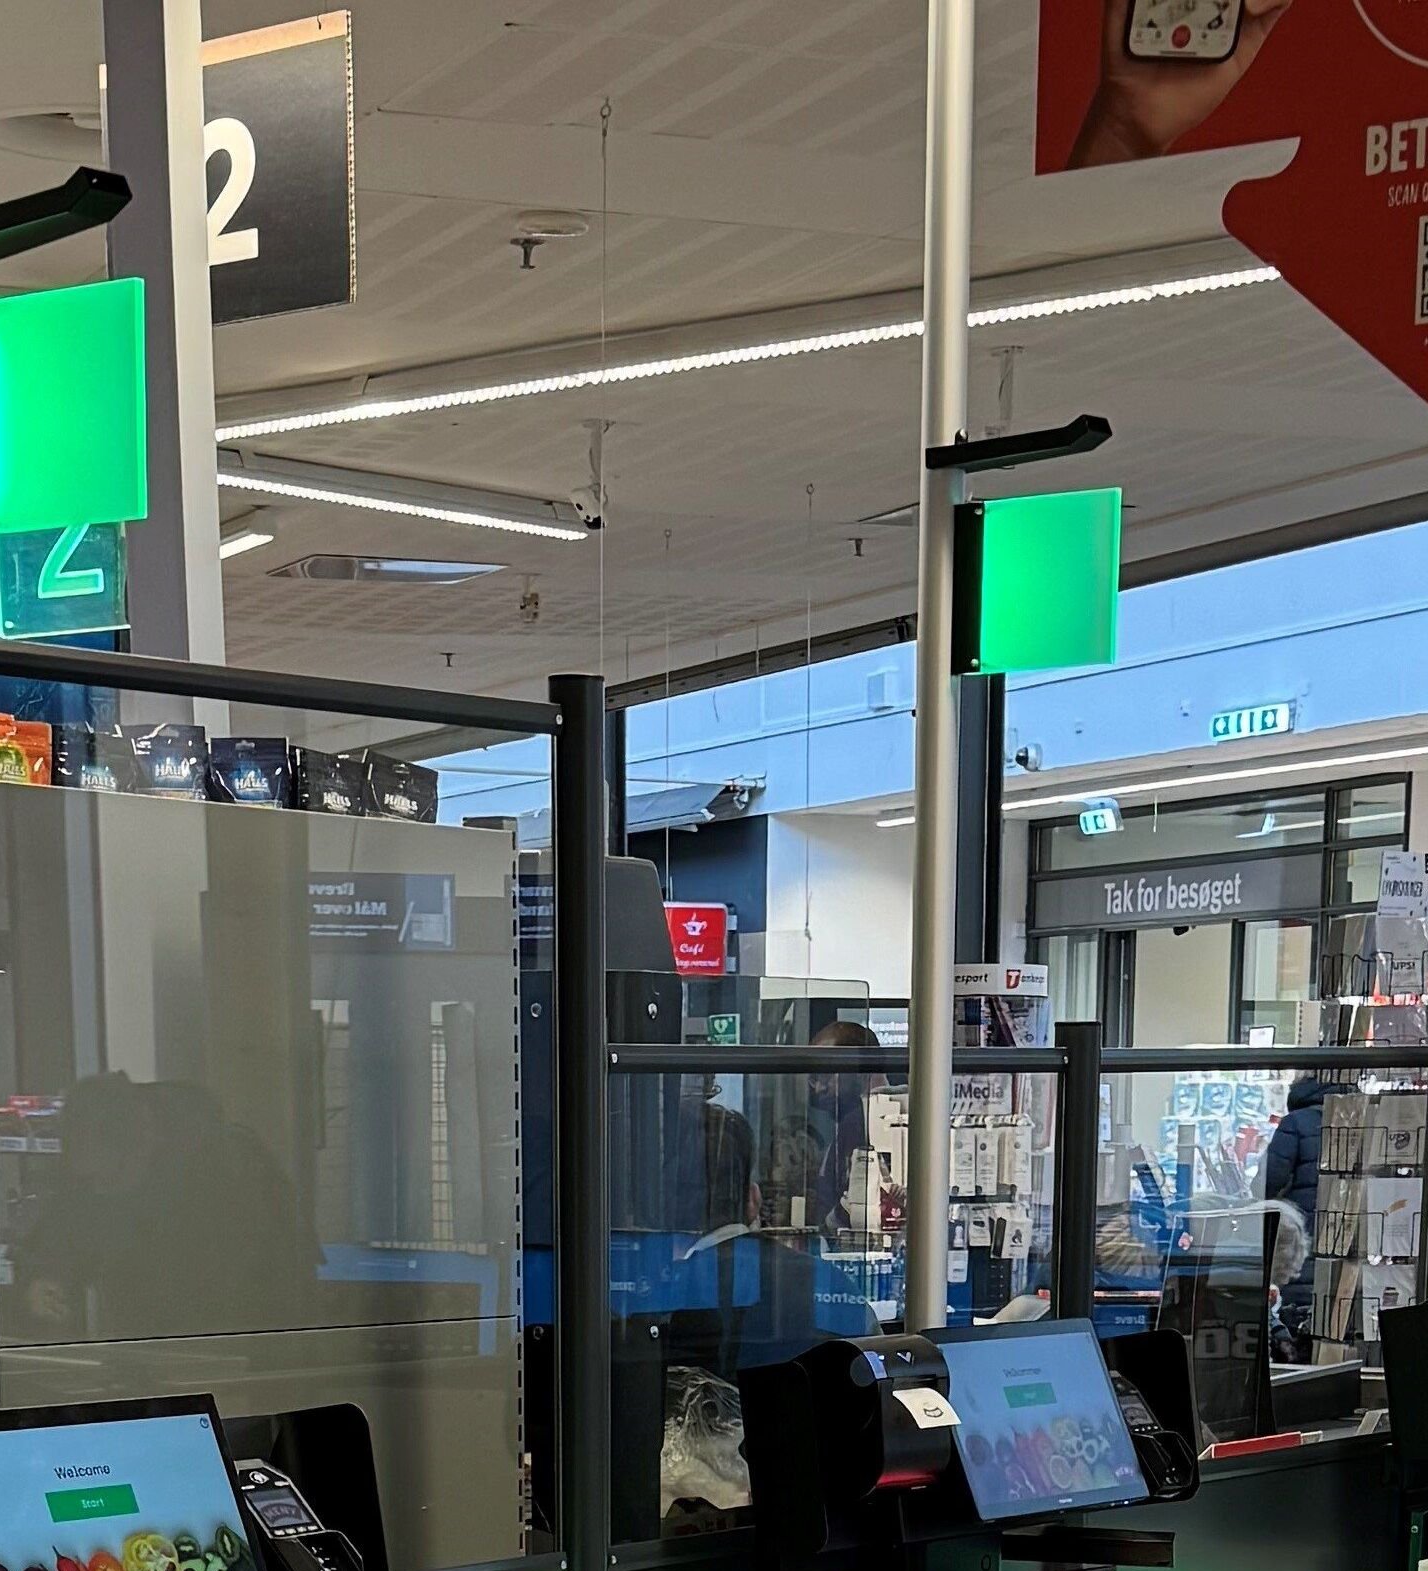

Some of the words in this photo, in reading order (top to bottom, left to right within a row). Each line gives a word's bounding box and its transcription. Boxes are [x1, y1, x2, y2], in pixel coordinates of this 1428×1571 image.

[208, 117, 259, 266] 2
[1387, 182, 1419, 207] SCAN
[1104, 880, 1133, 914] Tak
[1137, 878, 1163, 912] for
[1166, 872, 1242, 915] besøget
[54, 1464, 111, 1480] Welcome
